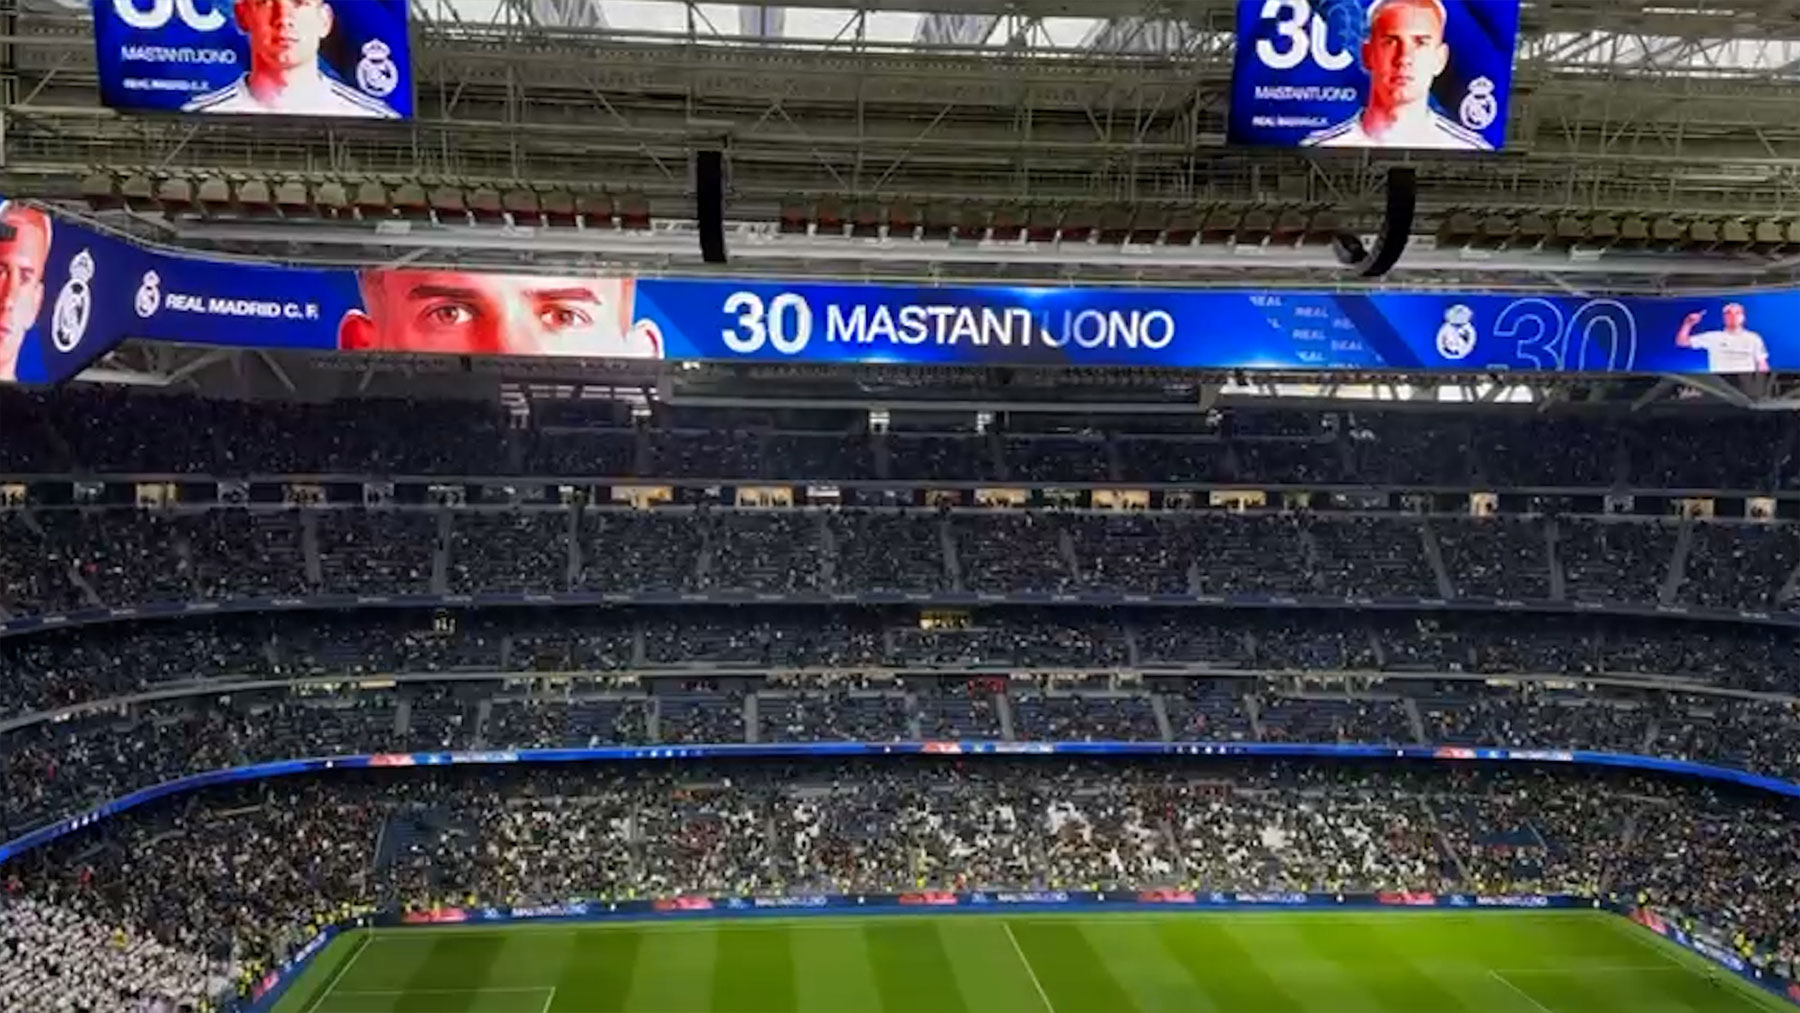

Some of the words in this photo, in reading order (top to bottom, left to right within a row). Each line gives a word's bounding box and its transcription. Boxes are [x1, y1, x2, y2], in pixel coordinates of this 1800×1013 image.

[165, 294, 206, 313] REAL
[208, 299, 281, 318] MADRID
[722, 291, 813, 354] 30
[826, 304, 1175, 349] MASTANTUONO
[1486, 298, 1637, 371] 30
